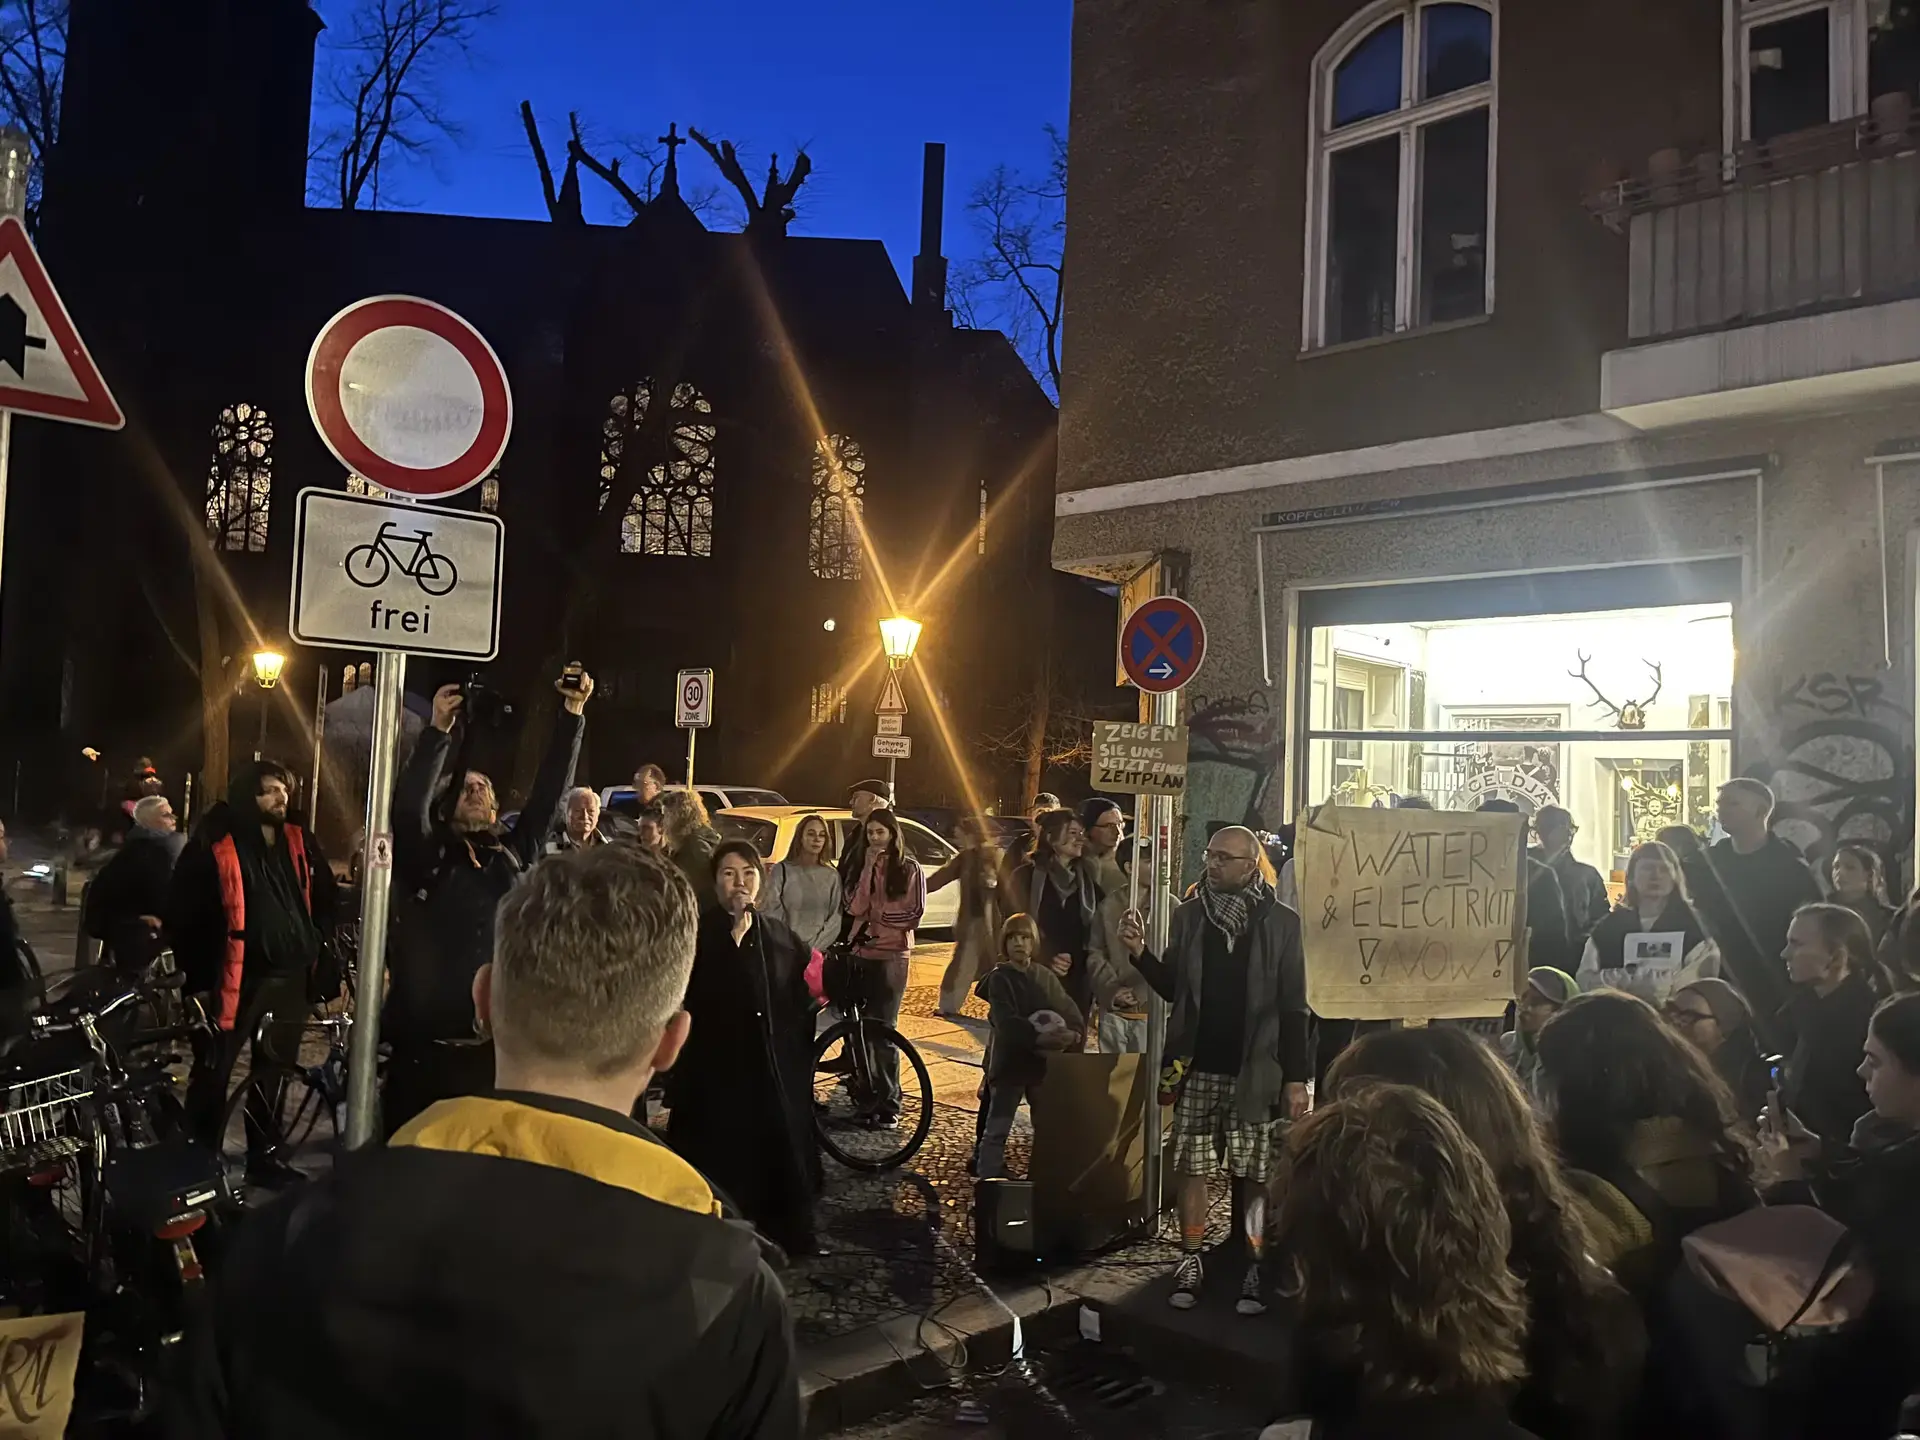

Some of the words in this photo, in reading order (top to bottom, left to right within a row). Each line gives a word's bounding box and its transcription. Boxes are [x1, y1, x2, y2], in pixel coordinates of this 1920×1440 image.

[371, 600, 430, 633] frei
[687, 686, 699, 701] 30
[684, 711, 700, 721] ZONE
[1105, 724, 1178, 742] ZEIGEN
[877, 739, 907, 749] Gehweg-
[1100, 743, 1126, 757] SIE
[1130, 746, 1164, 759] UNS
[1099, 757, 1149, 772] JETZT
[1099, 768, 1184, 789] ZEITPLAN
[1321, 894, 1339, 930] &
